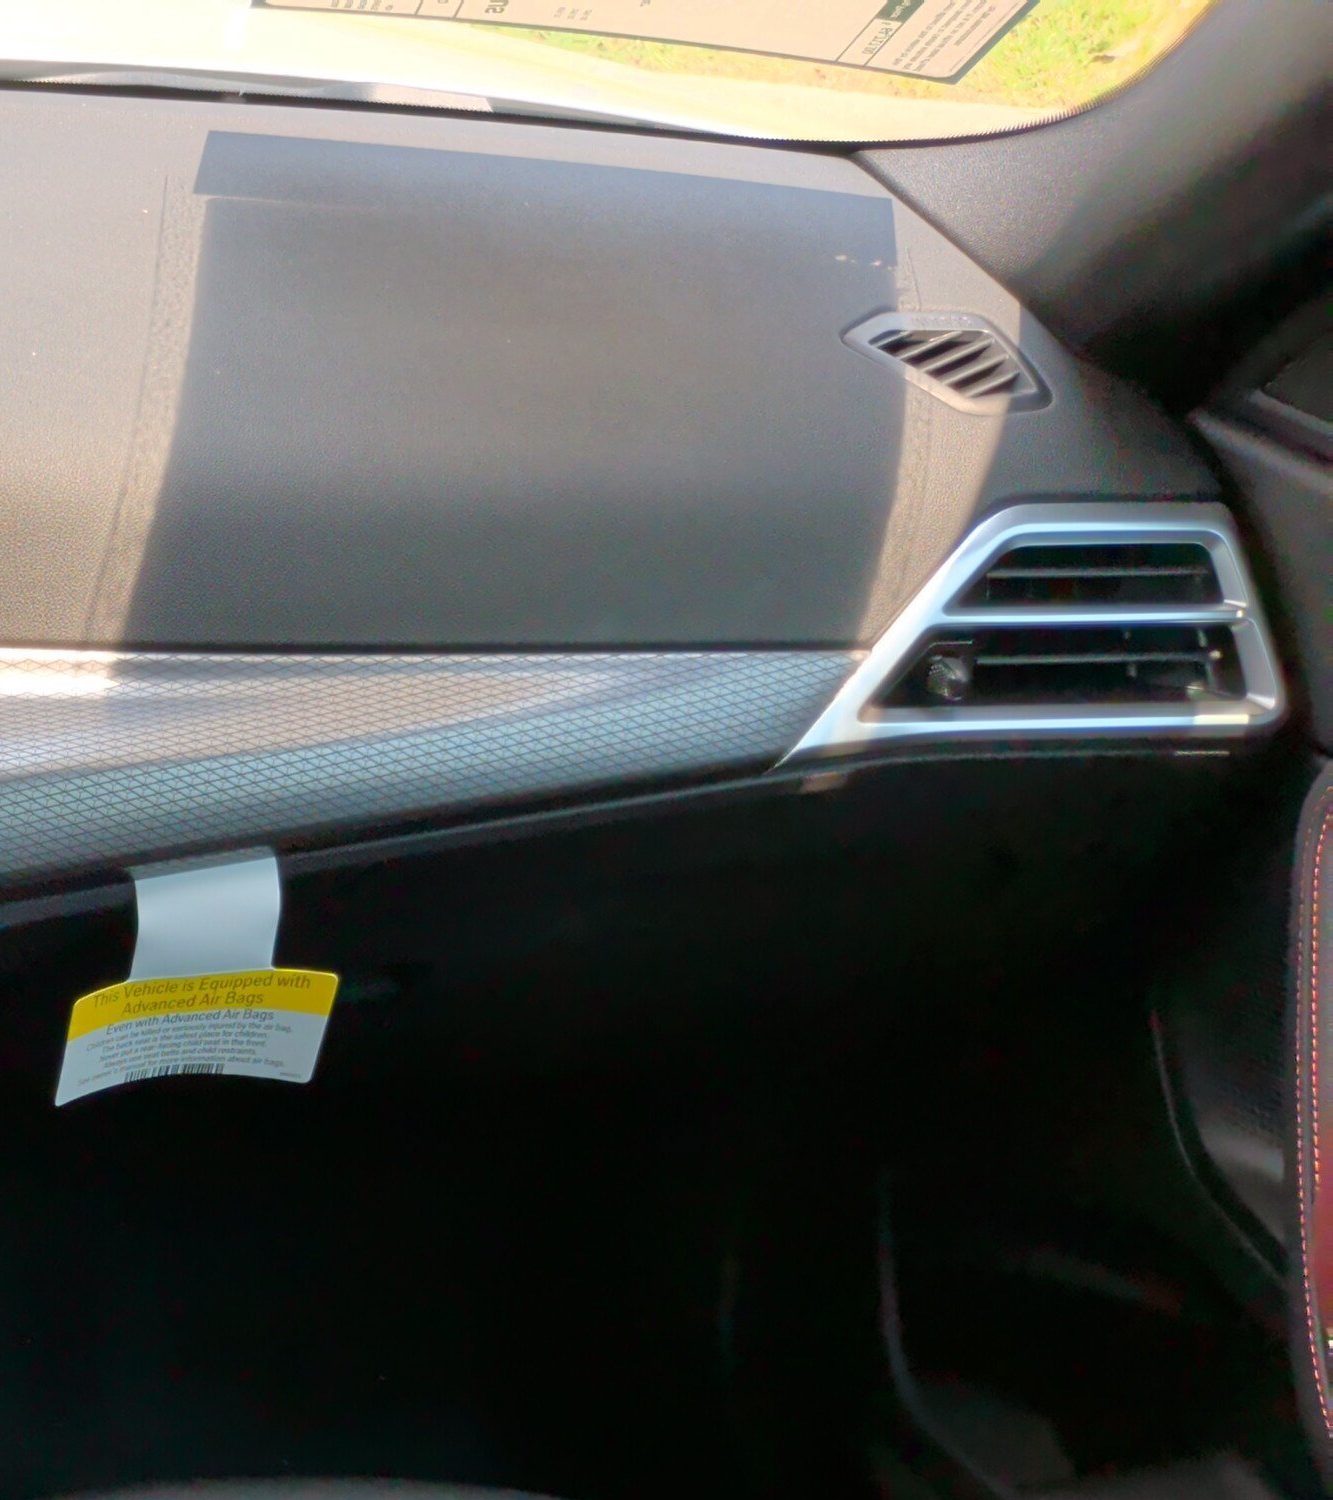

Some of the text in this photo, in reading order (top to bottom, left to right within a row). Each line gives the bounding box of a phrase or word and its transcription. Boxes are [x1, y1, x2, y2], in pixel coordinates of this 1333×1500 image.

[94, 973, 311, 1008] This Vehicle is Equipped with
[121, 990, 264, 1017] Advanced Air Bags
[105, 1008, 275, 1035] Even with Advanced Air Bags
